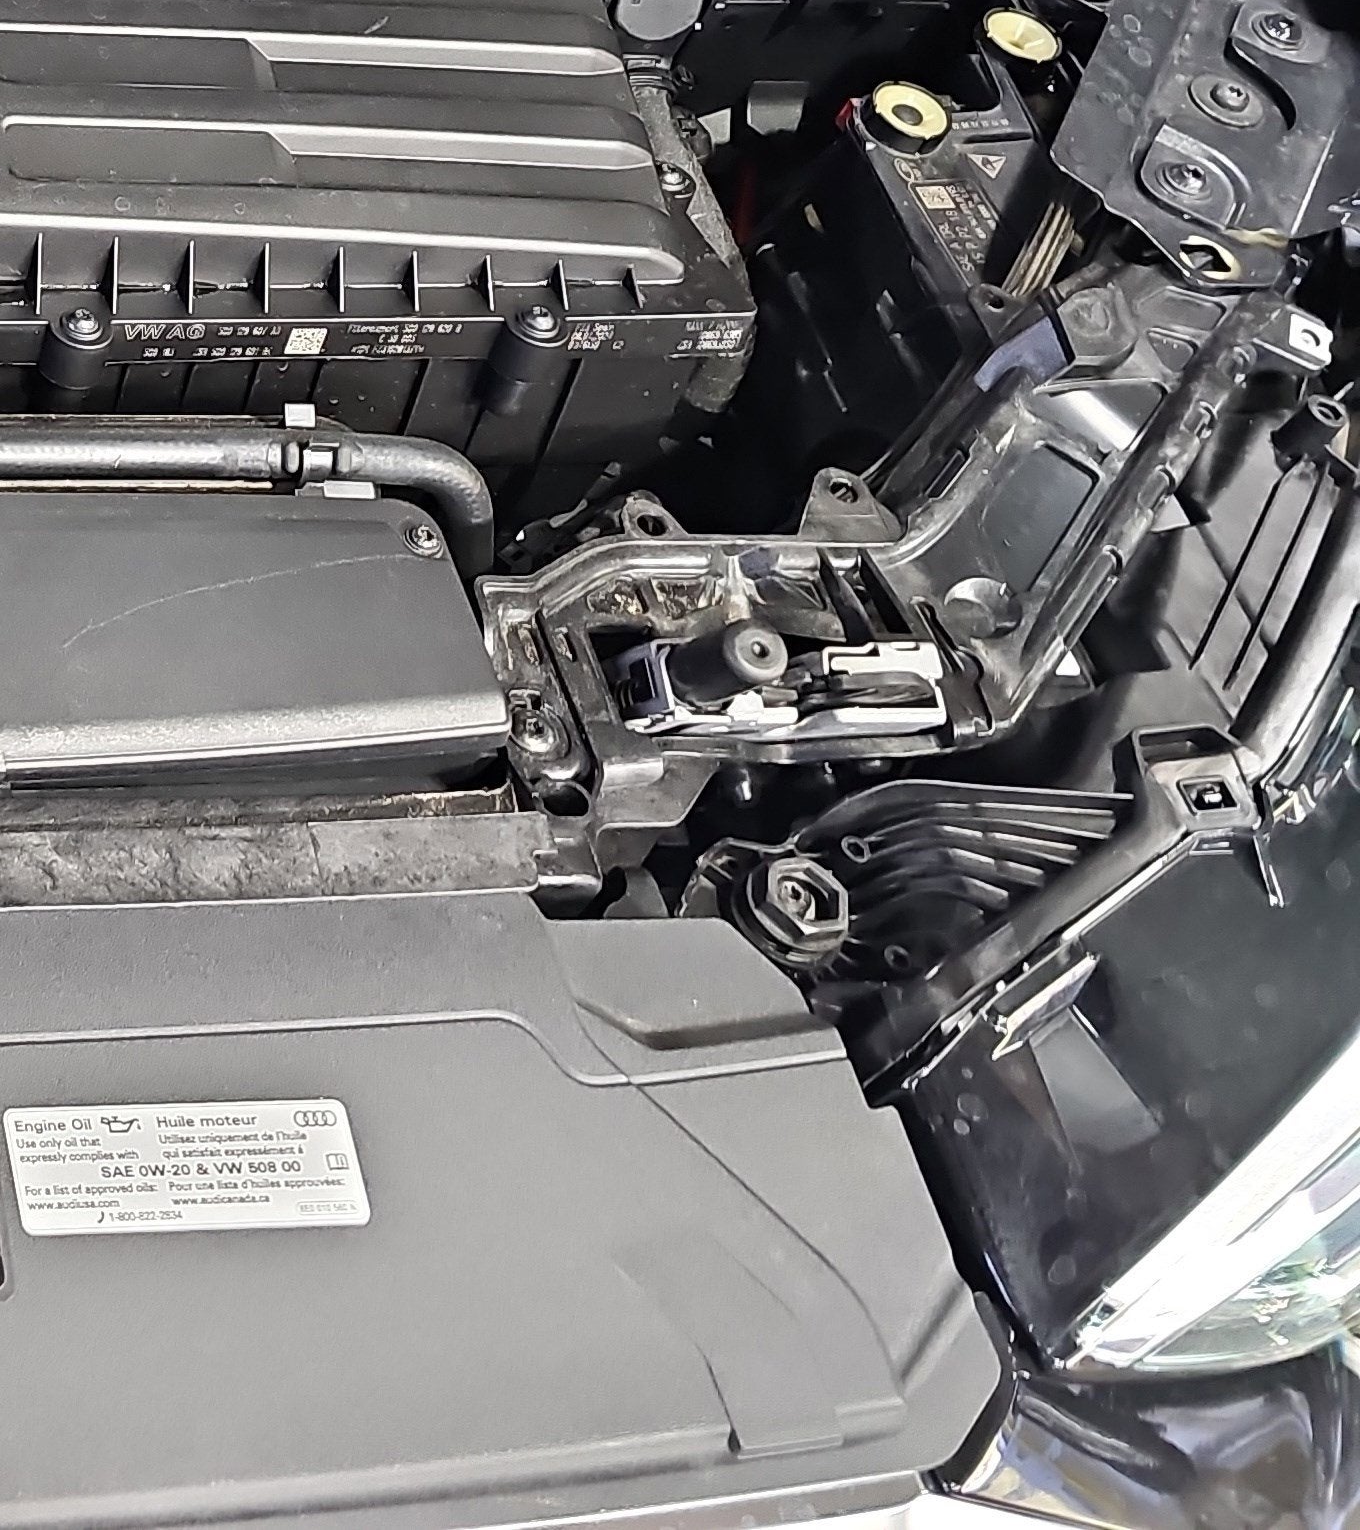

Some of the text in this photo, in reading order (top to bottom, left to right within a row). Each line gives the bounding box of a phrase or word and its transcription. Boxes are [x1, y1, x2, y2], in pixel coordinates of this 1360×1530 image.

[124, 323, 166, 340] VW
[166, 323, 206, 340] AG
[14, 1115, 257, 1134] Engine Oil Huile moteur
[16, 1136, 101, 1150] Use only oil that
[198, 1132, 259, 1145] uniquement
[261, 1132, 274, 1141] de
[20, 1150, 140, 1164] expressly complies with
[162, 1149, 179, 1160] qui
[224, 1146, 296, 1158] expressément
[100, 1160, 301, 1178] SAE 0W-20 & VW 508 00
[25, 1185, 41, 1196] For
[44, 1187, 51, 1195] a
[53, 1184, 70, 1195] list
[72, 1184, 82, 1194] of
[85, 1183, 134, 1196] approved
[168, 1181, 193, 1191] Pour
[195, 1181, 214, 1190] une
[216, 1179, 238, 1190] liste
